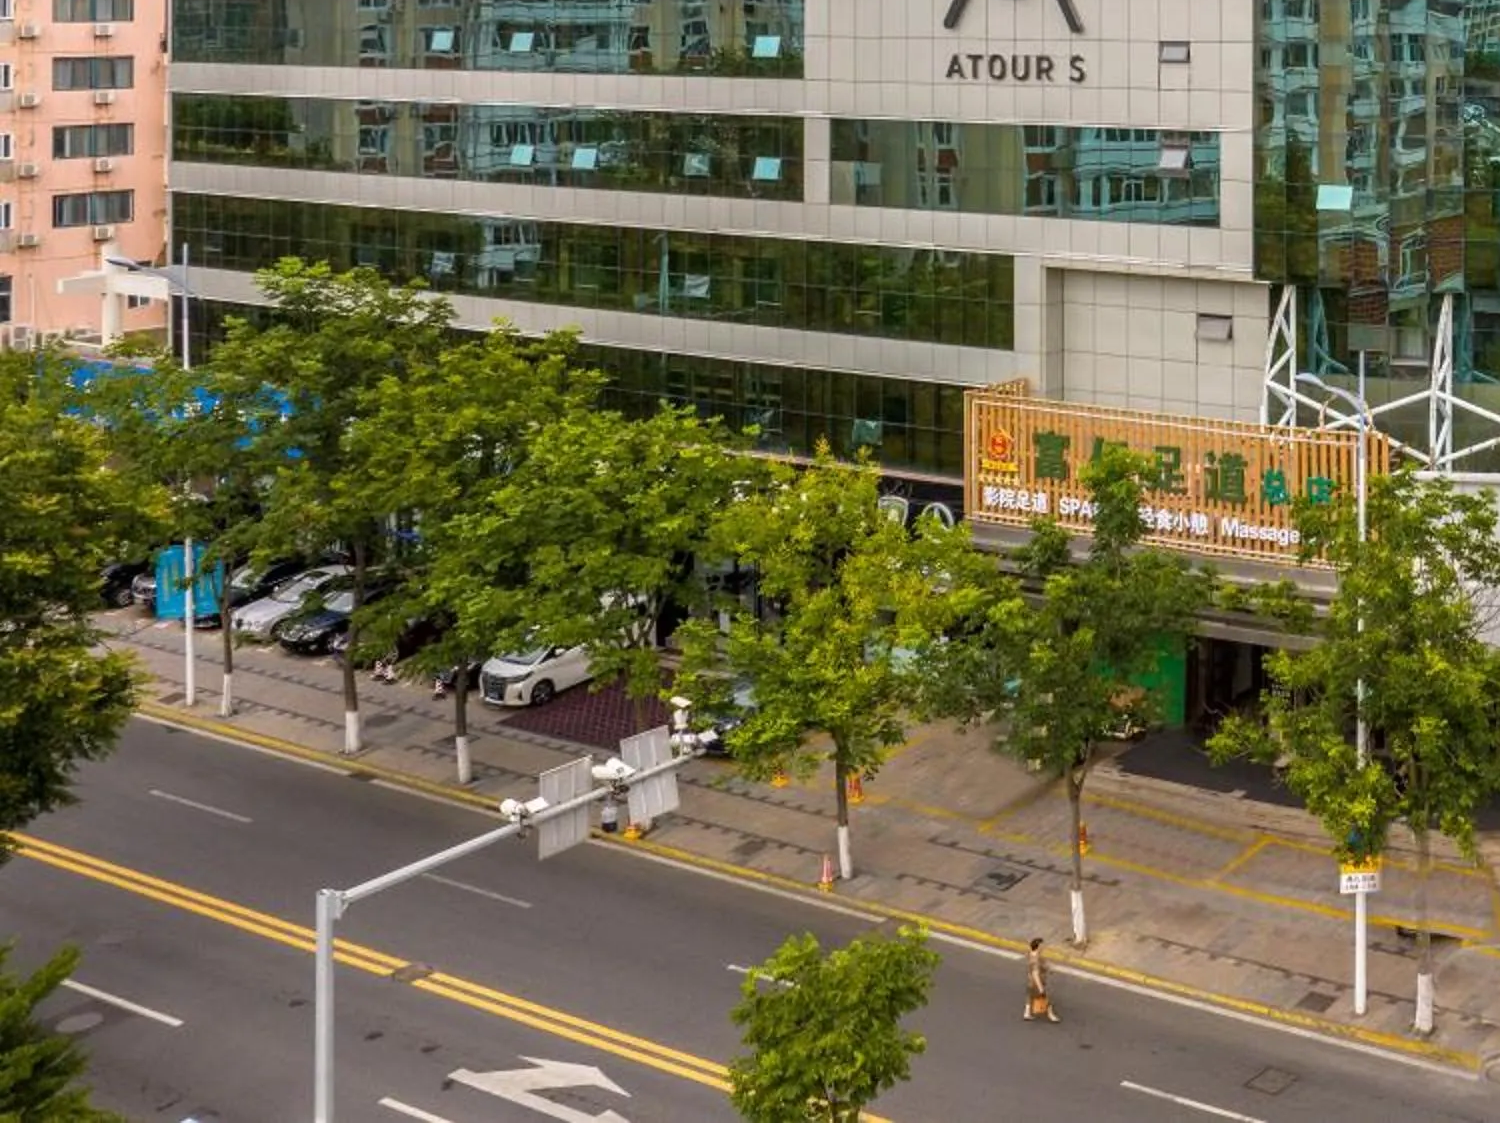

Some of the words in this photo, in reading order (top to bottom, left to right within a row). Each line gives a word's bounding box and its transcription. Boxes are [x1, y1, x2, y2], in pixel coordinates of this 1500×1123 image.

[945, 53, 1055, 82] ATOUR
[1069, 55, 1087, 83] S
[1032, 430, 1249, 503] 富足道
[1059, 496, 1100, 520] SPA
[1220, 516, 1301, 546] Massage
